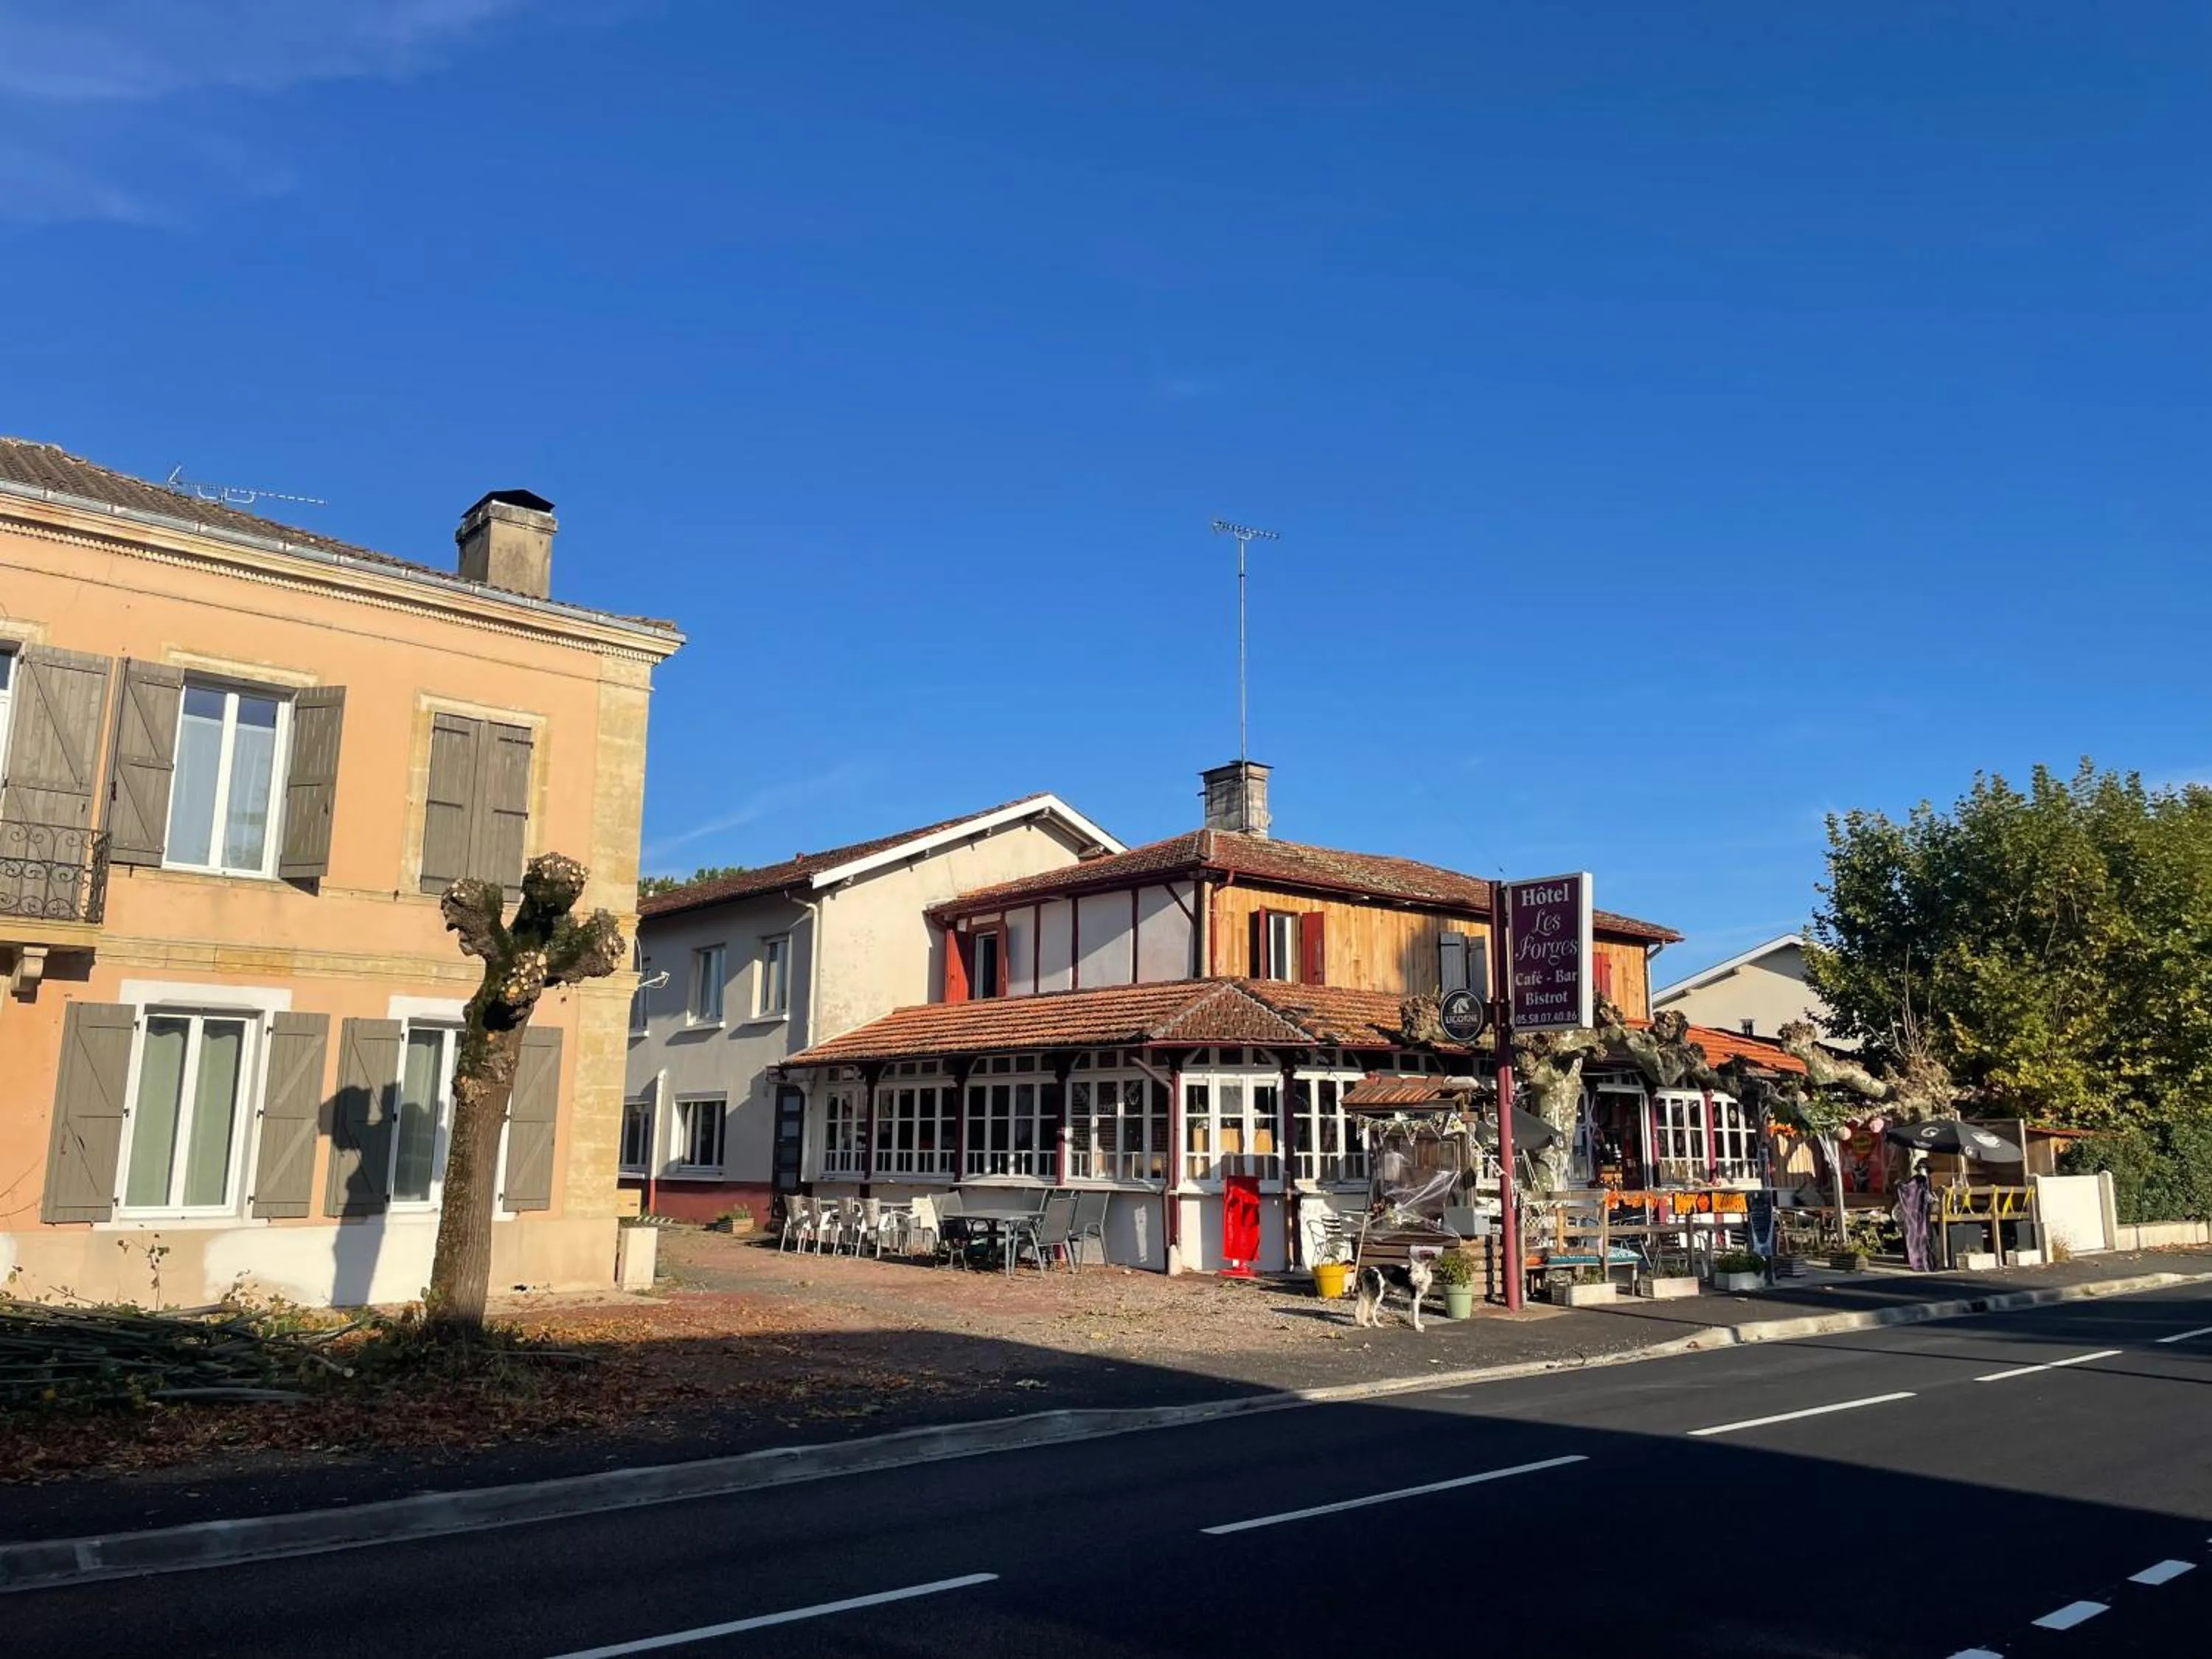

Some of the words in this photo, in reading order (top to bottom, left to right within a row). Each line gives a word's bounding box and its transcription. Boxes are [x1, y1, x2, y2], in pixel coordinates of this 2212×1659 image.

[1521, 883, 1569, 907] Hôtel
[1534, 908, 1561, 936] Les
[1515, 933, 1578, 966] Forges
[1515, 971, 1543, 987] Café
[1555, 970, 1578, 984] Bar
[1526, 991, 1568, 1006] Bistrot
